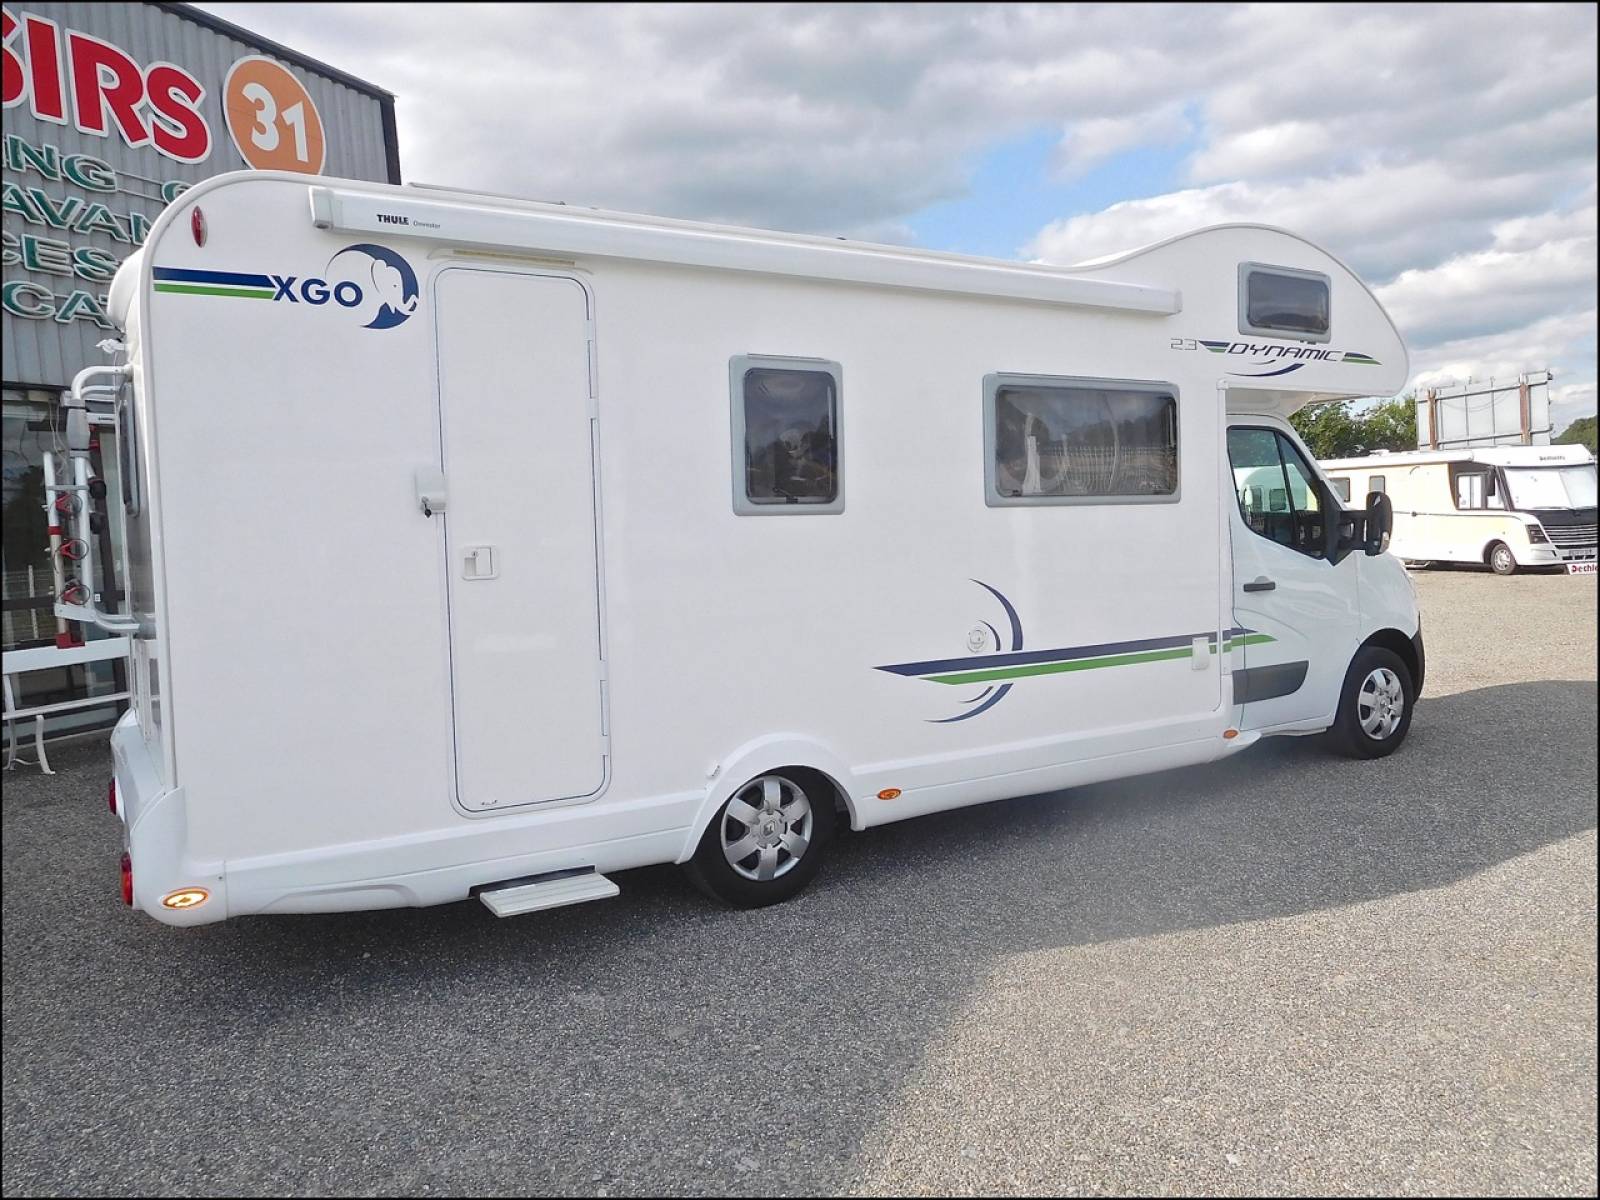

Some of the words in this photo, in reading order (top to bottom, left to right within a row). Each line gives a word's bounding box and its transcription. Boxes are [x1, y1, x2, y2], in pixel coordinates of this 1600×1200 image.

[242, 82, 309, 163] 31
[376, 214, 409, 225] THULE
[272, 275, 364, 307] XGO
[1171, 338, 1198, 351] 23
[1227, 343, 1344, 362] DYNAMIC
